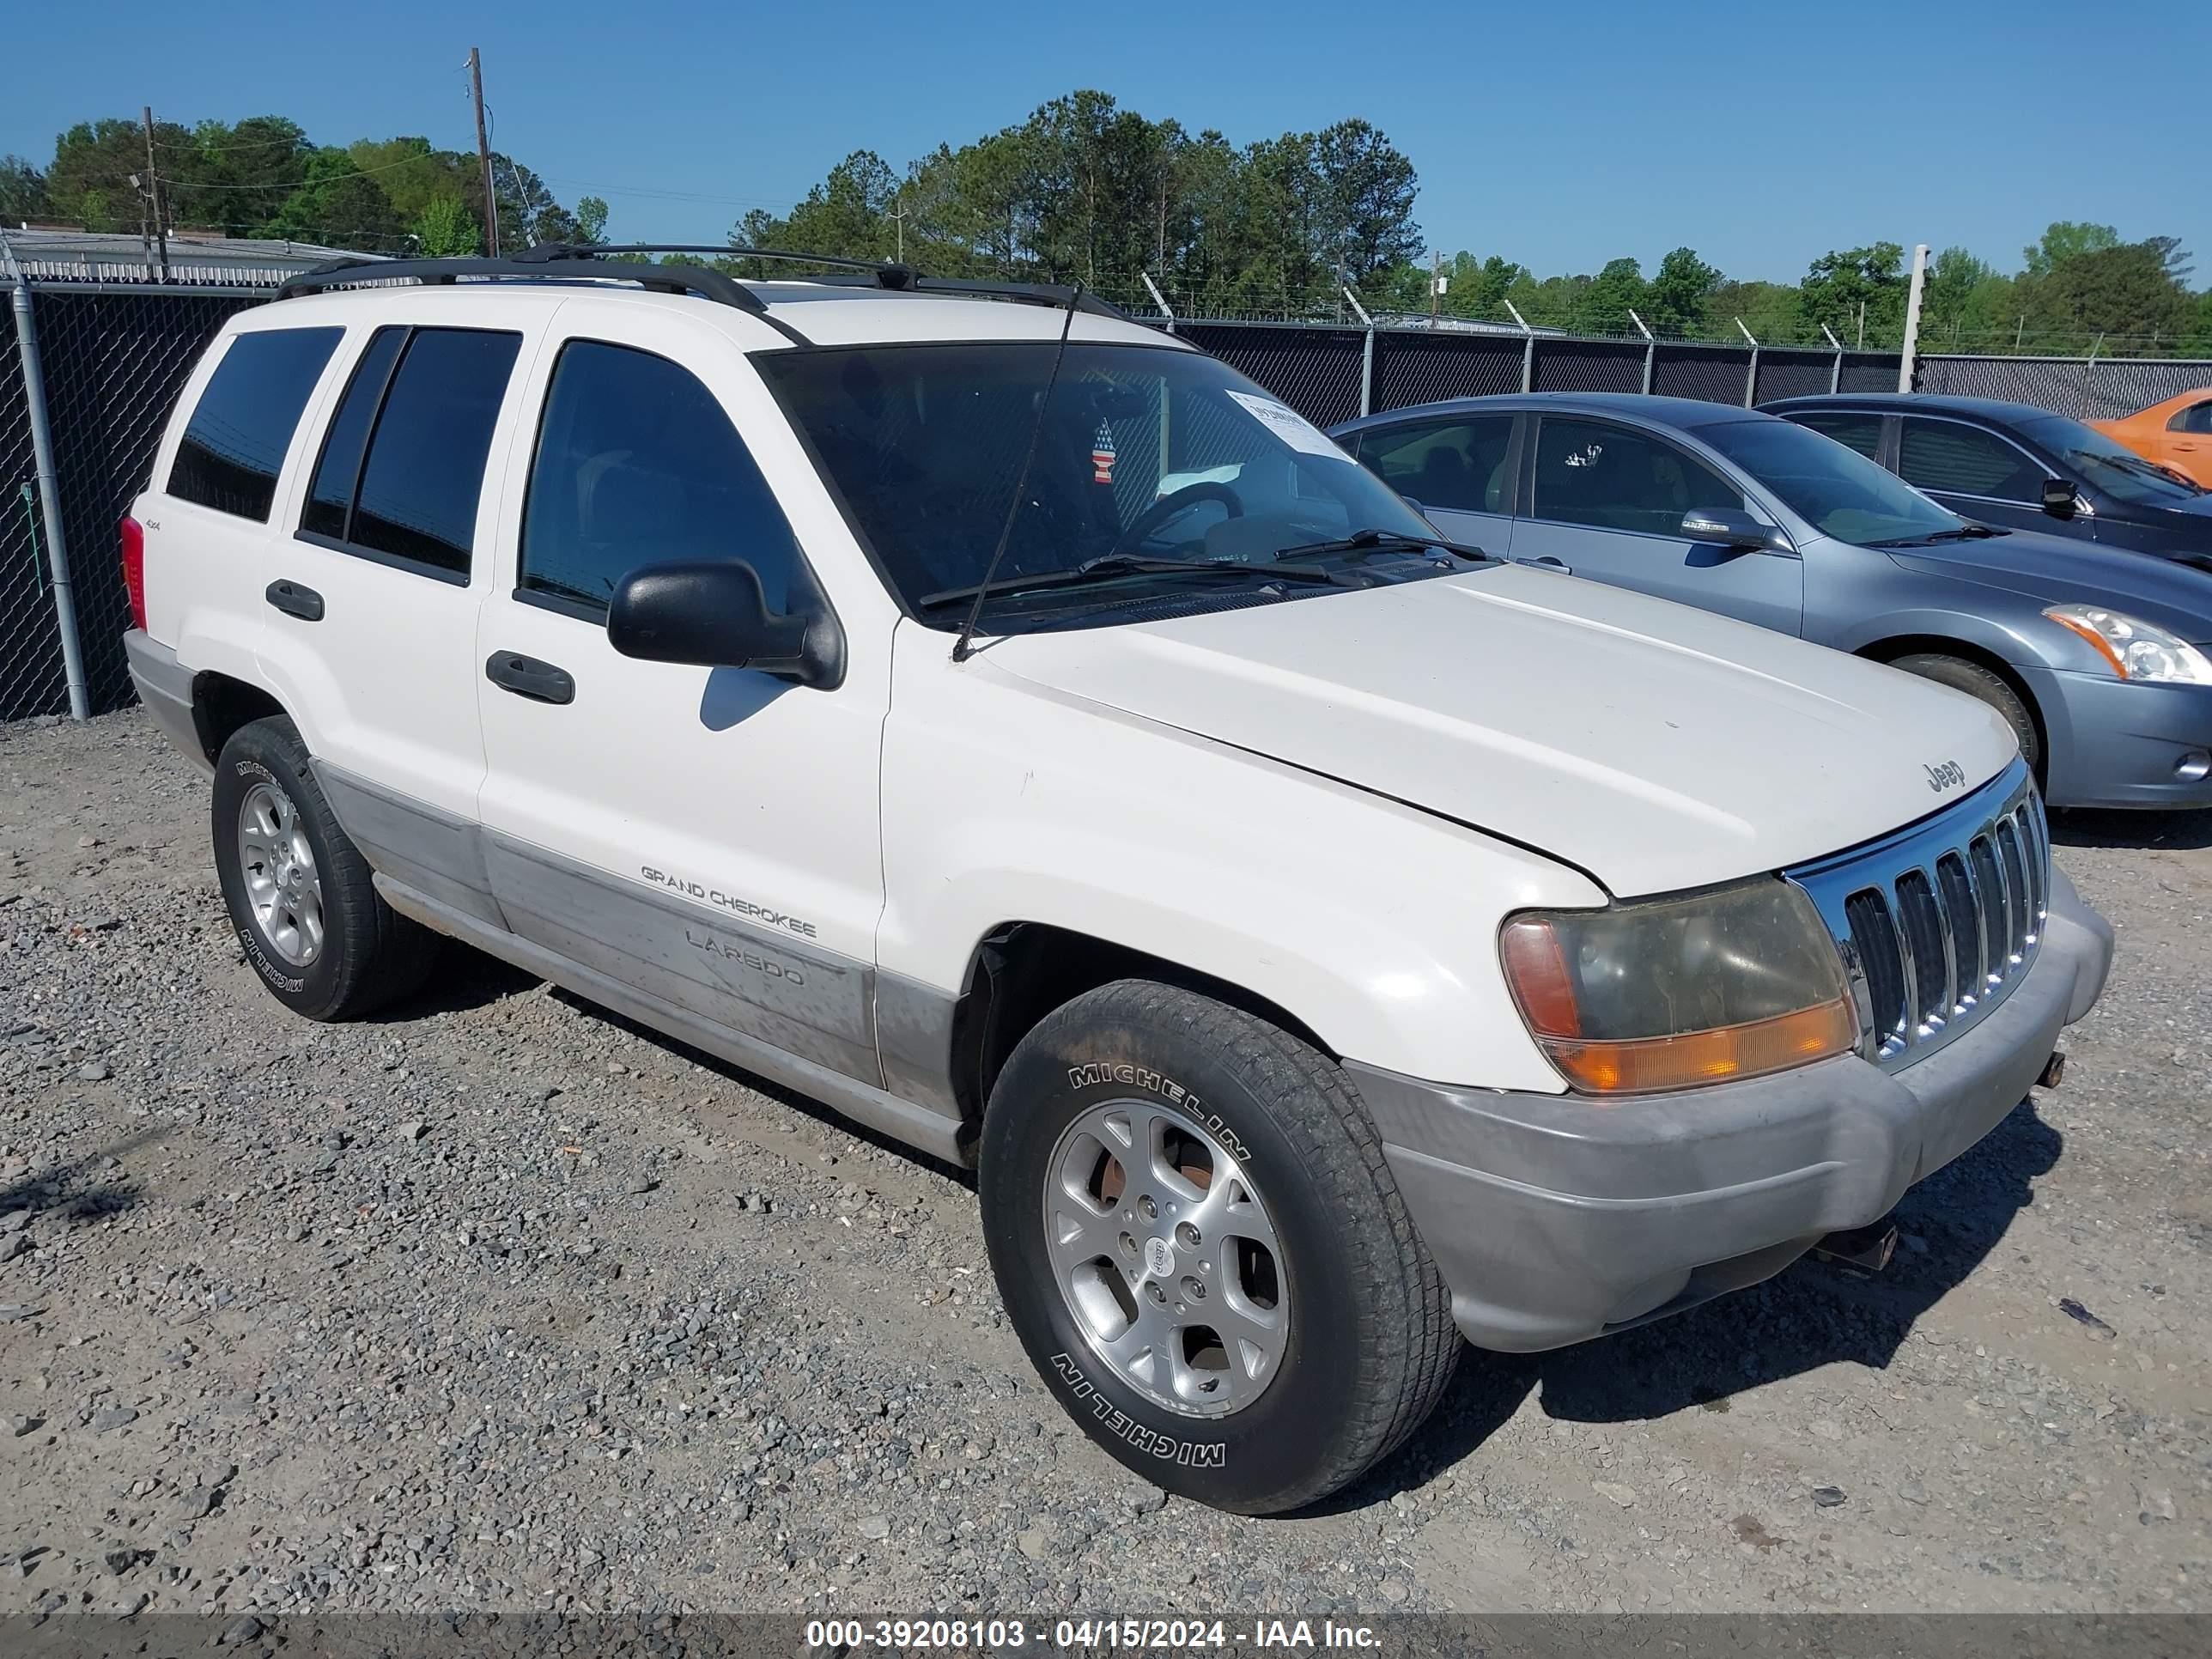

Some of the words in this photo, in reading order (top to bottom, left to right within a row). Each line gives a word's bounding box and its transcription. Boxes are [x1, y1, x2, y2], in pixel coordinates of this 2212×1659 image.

[1922, 760, 1966, 793] Jeep
[641, 865, 705, 899] GRAND
[710, 890, 817, 939] CHEROKEE
[241, 927, 304, 994] MICHELIN
[684, 927, 805, 986] LAREDO
[1067, 1062, 1252, 1162] MICHELIN
[1049, 1352, 1227, 1468] MICHELIN
